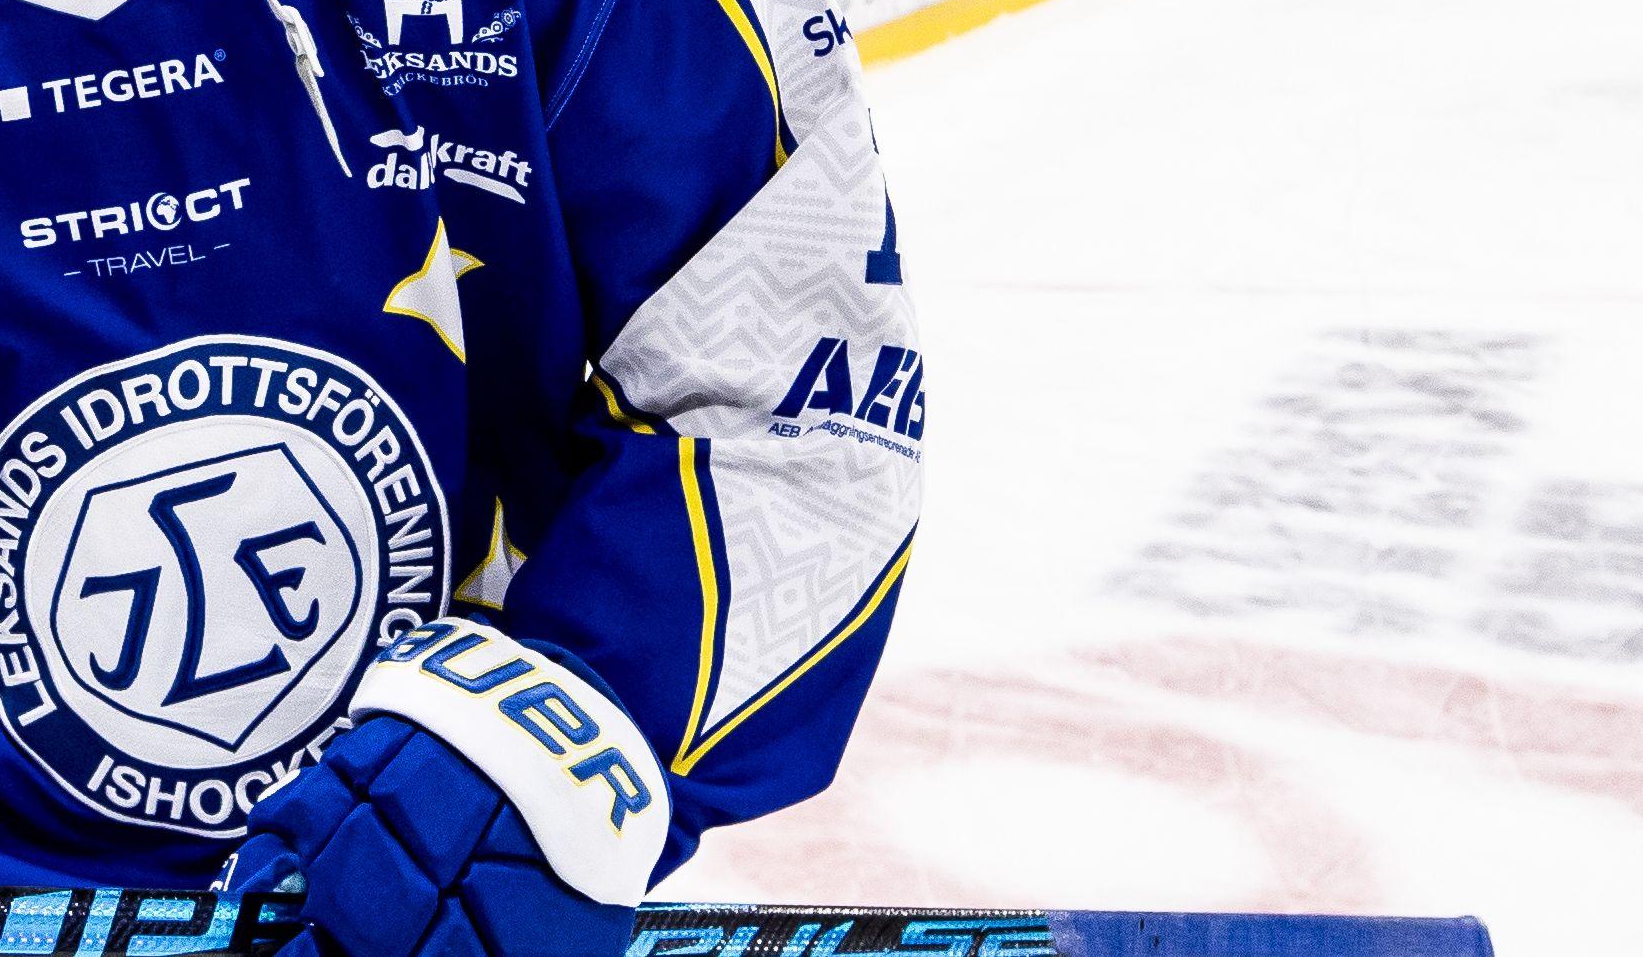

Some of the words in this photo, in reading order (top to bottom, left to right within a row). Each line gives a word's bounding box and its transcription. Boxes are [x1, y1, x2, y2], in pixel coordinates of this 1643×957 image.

[367, 133, 533, 191] dalkraft
[767, 422, 802, 439] AEB
[87, 716, 354, 825] ISHOCK
